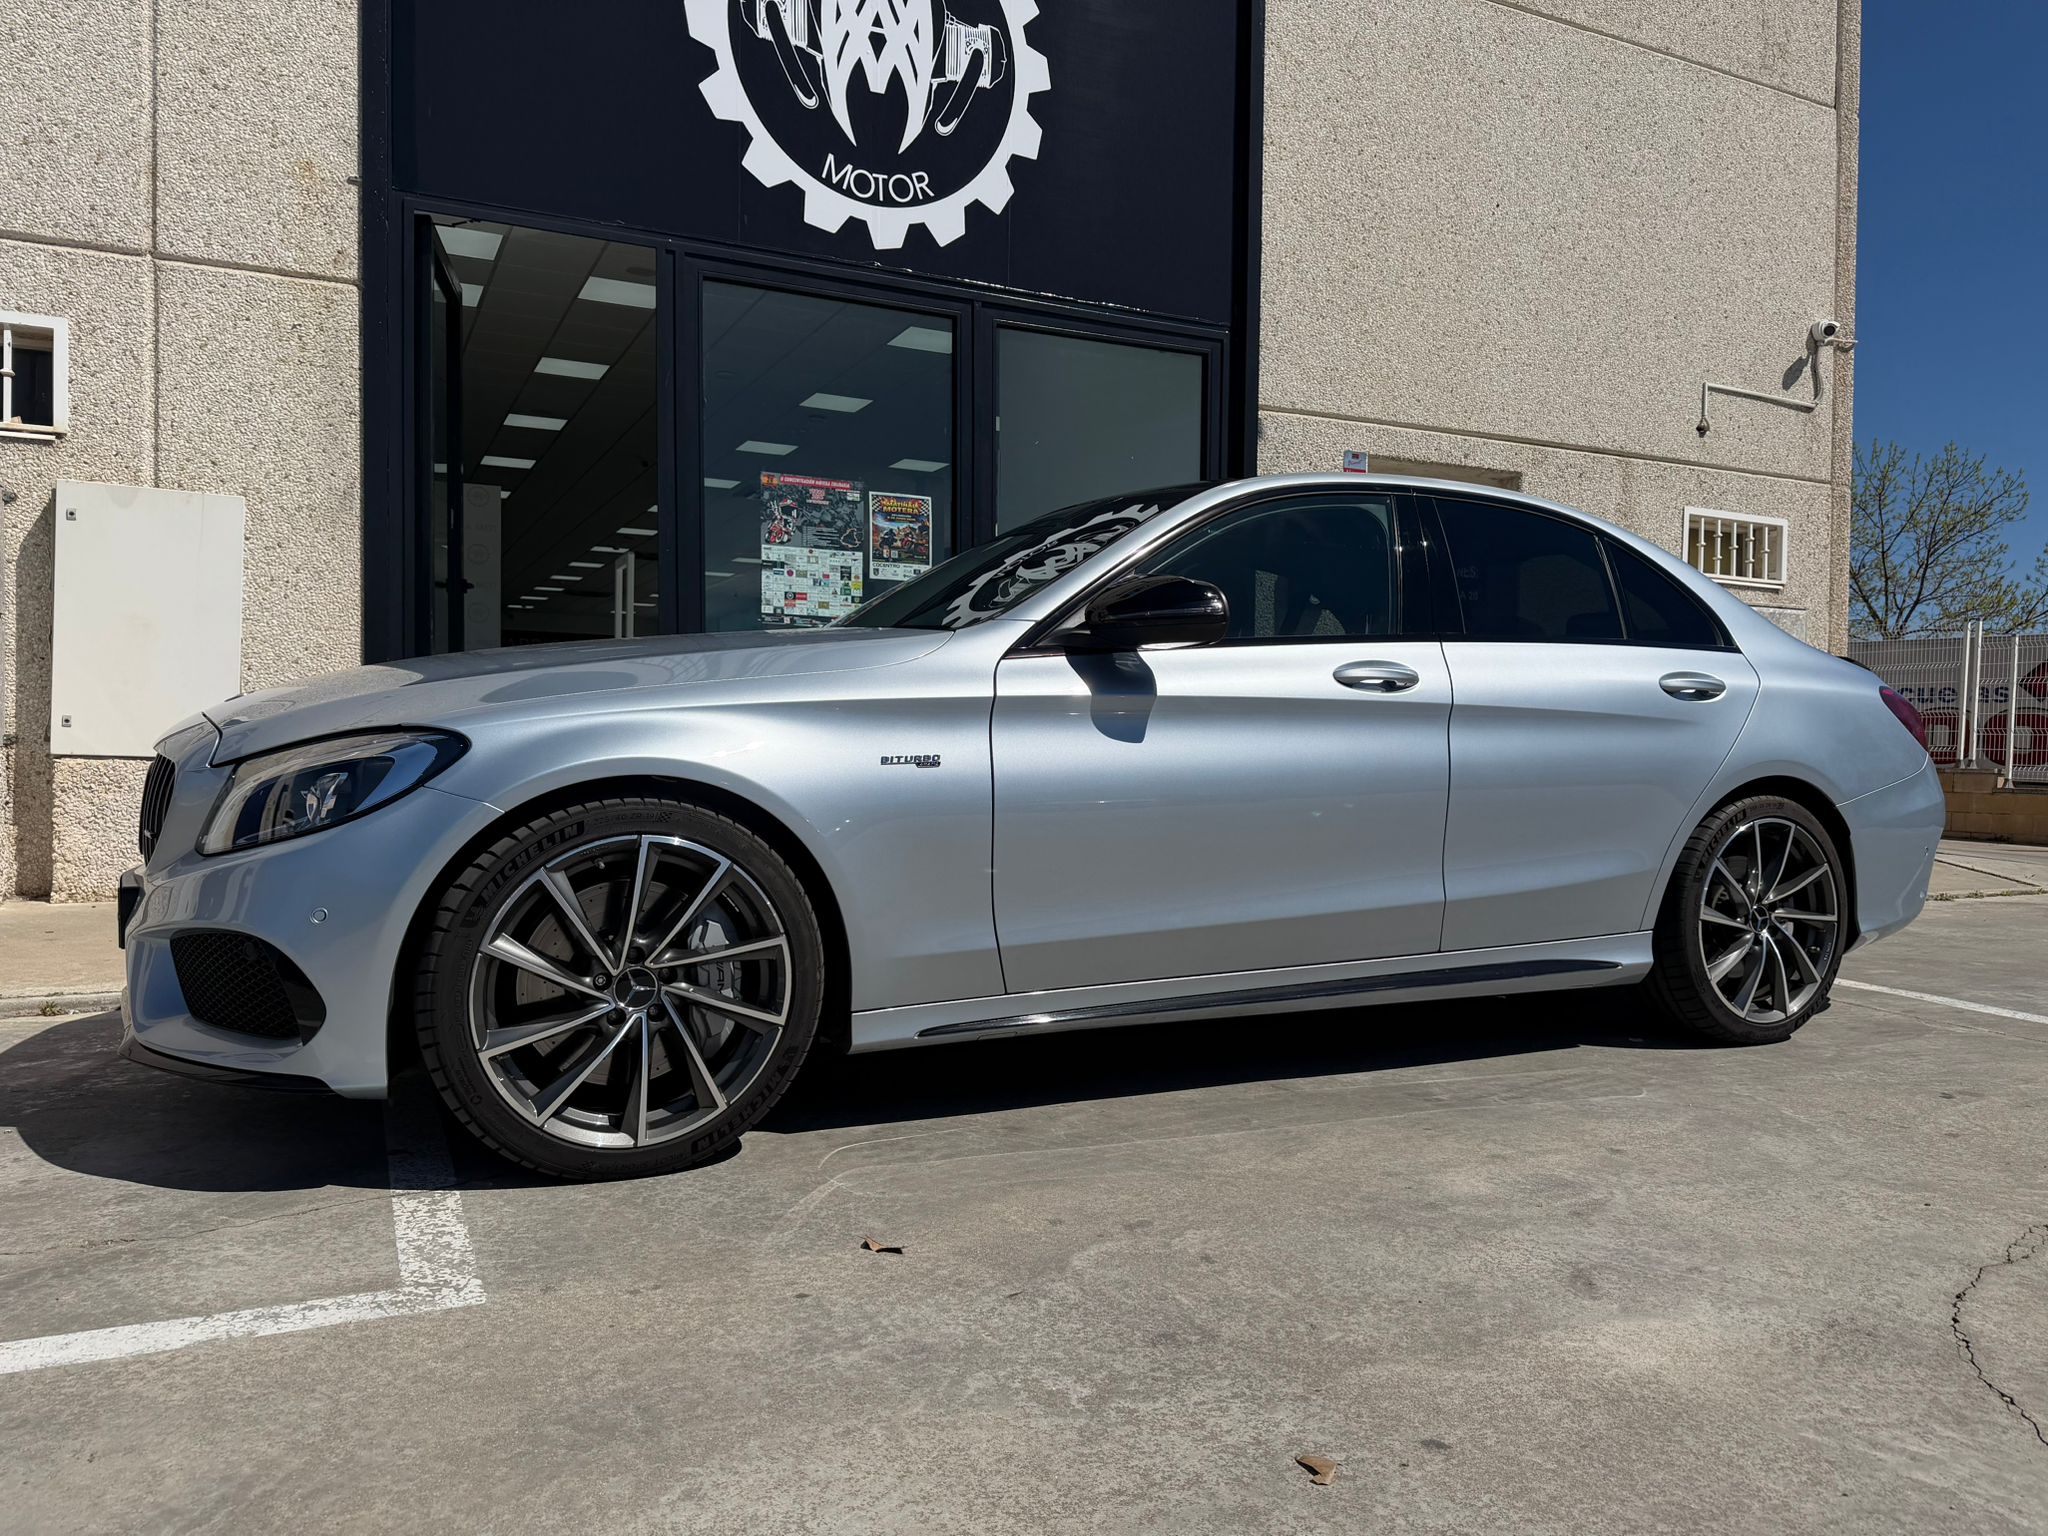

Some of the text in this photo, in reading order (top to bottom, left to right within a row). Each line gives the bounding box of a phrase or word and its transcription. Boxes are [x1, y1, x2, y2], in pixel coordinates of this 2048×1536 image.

[821, 153, 935, 204] MOTOR
[882, 506, 919, 514] MOTERA
[880, 754, 941, 765] BITURBO
[480, 822, 578, 903] MICHELIN
